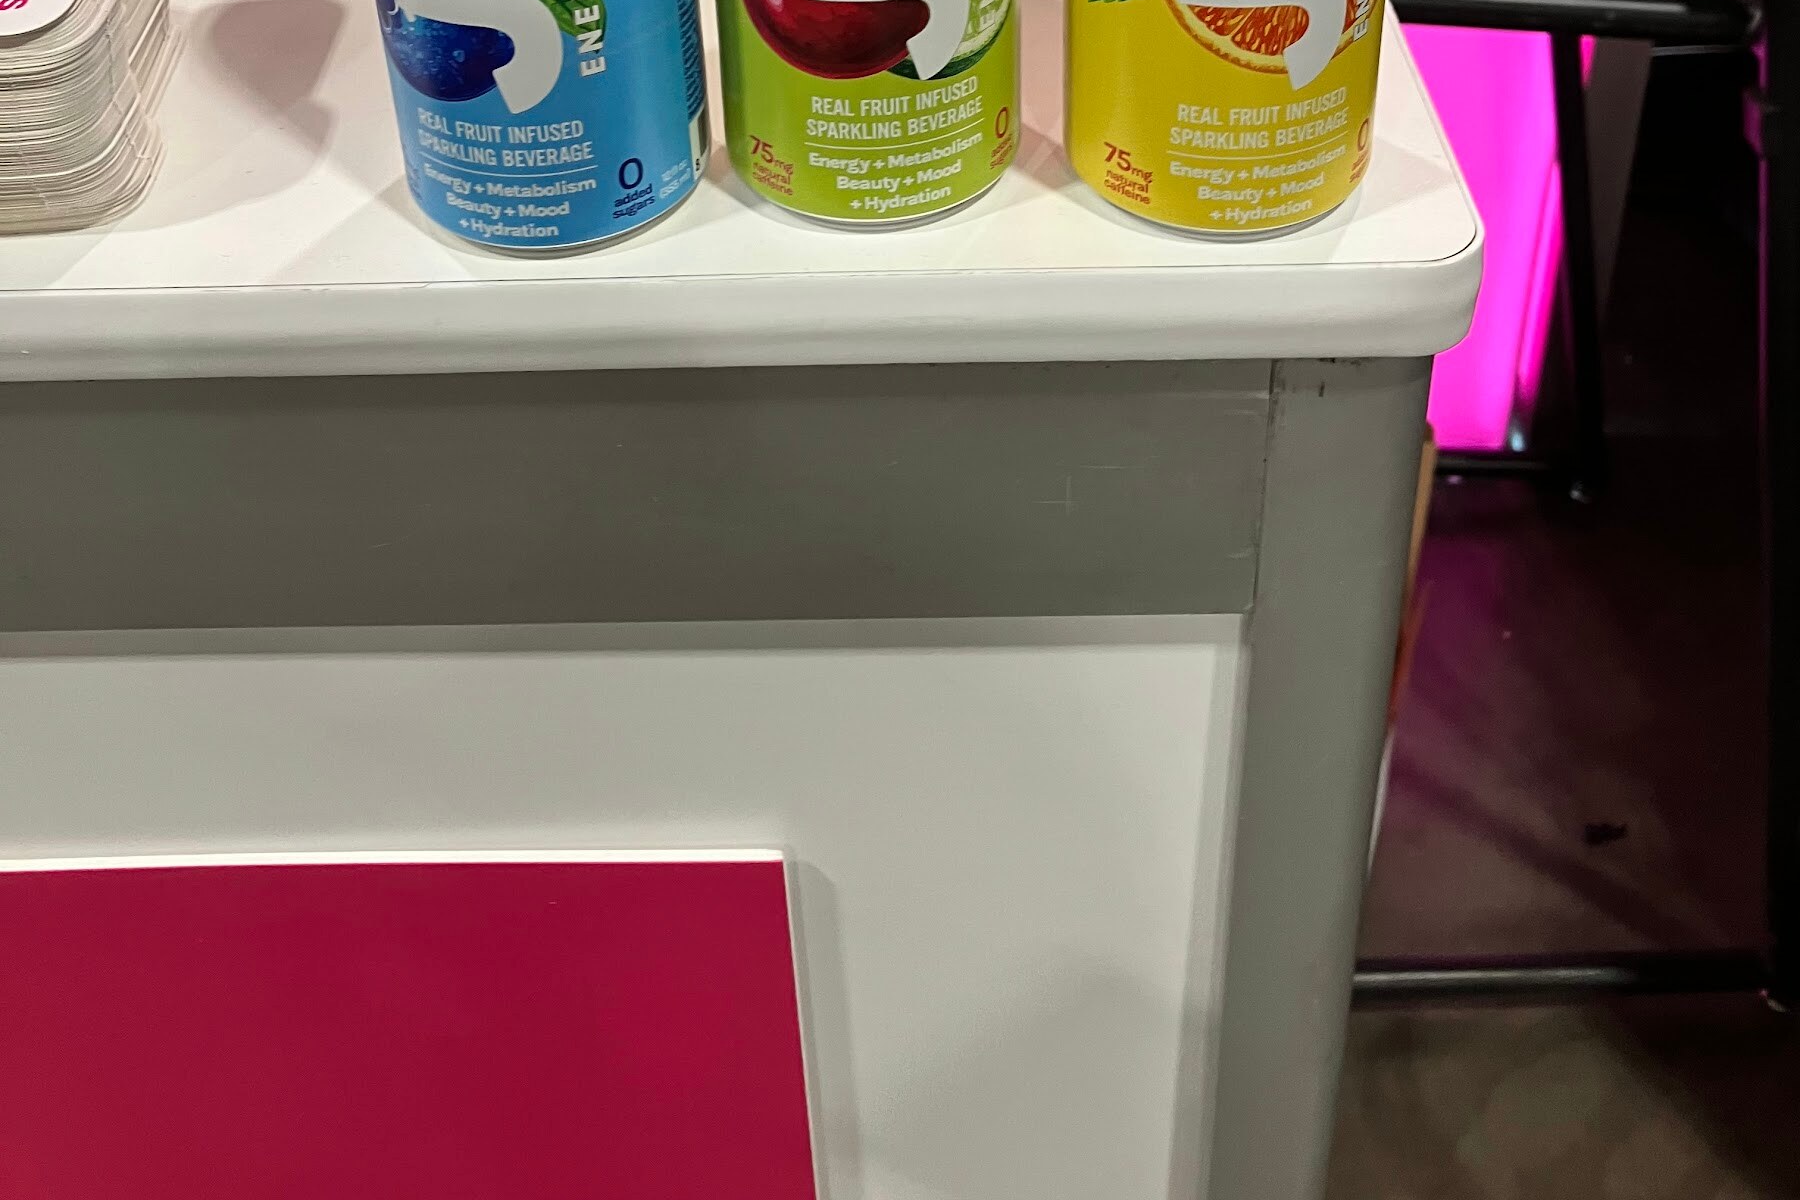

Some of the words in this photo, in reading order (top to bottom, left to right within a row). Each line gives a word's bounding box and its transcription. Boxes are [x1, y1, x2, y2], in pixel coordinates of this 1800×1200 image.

[811, 96, 855, 118] REAL
[860, 96, 911, 117] FRUIT
[916, 76, 978, 111] INFUSED
[1177, 104, 1223, 126] REAL
[1229, 105, 1280, 126] FRUIT
[1286, 86, 1347, 121] INFUSED
[417, 107, 453, 136] REAL
[455, 120, 502, 144] FRUIT
[508, 119, 584, 145] INFUSED
[806, 118, 901, 141] SPARKLING
[907, 96, 983, 136] BEVERAGE
[1170, 127, 1269, 150] SPARKLING
[1276, 107, 1349, 147] BEVERAGE
[418, 130, 498, 167] SPARKLING
[502, 141, 594, 168] BEVERAGE
[809, 152, 869, 174] Energy
[887, 132, 983, 169] Metabolism
[1104, 141, 1153, 184] 75mg
[1170, 162, 1233, 185] Energy
[1252, 144, 1346, 180] Metabolism
[423, 163, 472, 196] Energy
[486, 177, 598, 198] Metabolism
[836, 175, 901, 193] Beauty
[917, 159, 962, 183] Mood
[1104, 178, 1151, 206] caffeine
[1106, 169, 1149, 194] natural
[1197, 185, 1264, 204] Beauty
[1280, 174, 1324, 196] Mood
[446, 192, 502, 219] Beauty
[518, 202, 571, 217] Mood
[612, 196, 656, 219] sugars
